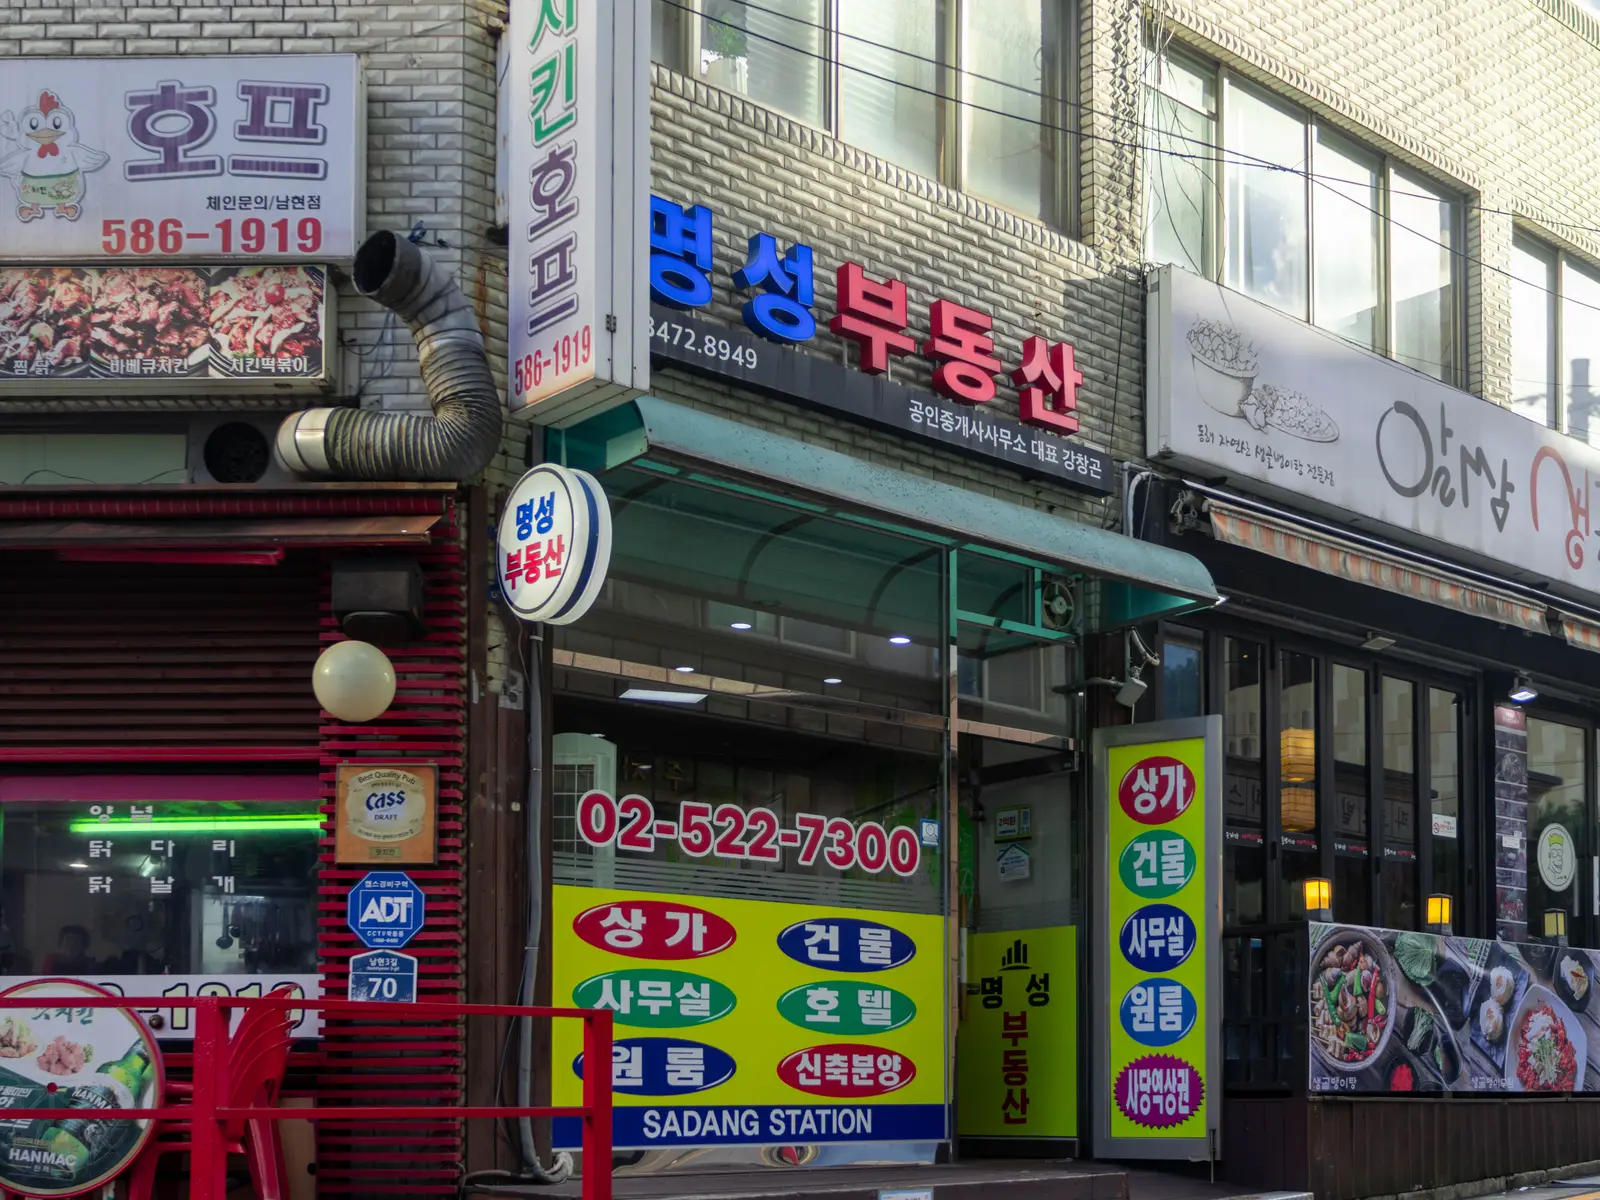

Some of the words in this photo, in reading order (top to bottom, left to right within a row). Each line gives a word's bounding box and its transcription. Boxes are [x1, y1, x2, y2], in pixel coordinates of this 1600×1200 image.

[125, 79, 330, 182] 호프
[206, 195, 321, 211] 체인문의/남현점
[102, 217, 322, 253] 586-1919
[110, 356, 189, 375] 바베큐치킨
[230, 356, 309, 375] 치킨떡볶이
[515, 325, 591, 396] 586-1919
[908, 400, 1027, 454] 공인중개사사무소
[1031, 440, 1058, 464] 대표
[1062, 448, 1102, 480] 강창곤
[1198, 424, 1214, 443] 동해
[1219, 434, 1251, 456] 자연산
[1307, 463, 1335, 487] 전문점
[516, 491, 555, 541] 명성
[505, 535, 565, 590] 부동산
[357, 773, 374, 784] Best
[375, 771, 401, 781] Quality
[402, 774, 416, 785] Pub
[1131, 764, 1186, 814] 상가
[577, 789, 920, 877] 02-522-7300
[1133, 839, 1185, 887] 건물
[360, 896, 413, 923] ADT
[1128, 915, 1184, 958] 사무실
[368, 978, 397, 998] 70
[593, 979, 711, 1017] 사무실
[1131, 985, 1183, 1032] 원룸
[796, 1054, 902, 1087] 신축분양
[1001, 1011, 1030, 1124] 부동산
[72, 1087, 113, 1109] HANMA
[1126, 1068, 1190, 1115] 사당역상권
[643, 1109, 759, 1139] SADANG
[769, 1108, 872, 1136] STATION
[9, 1149, 77, 1166] HANMAC
